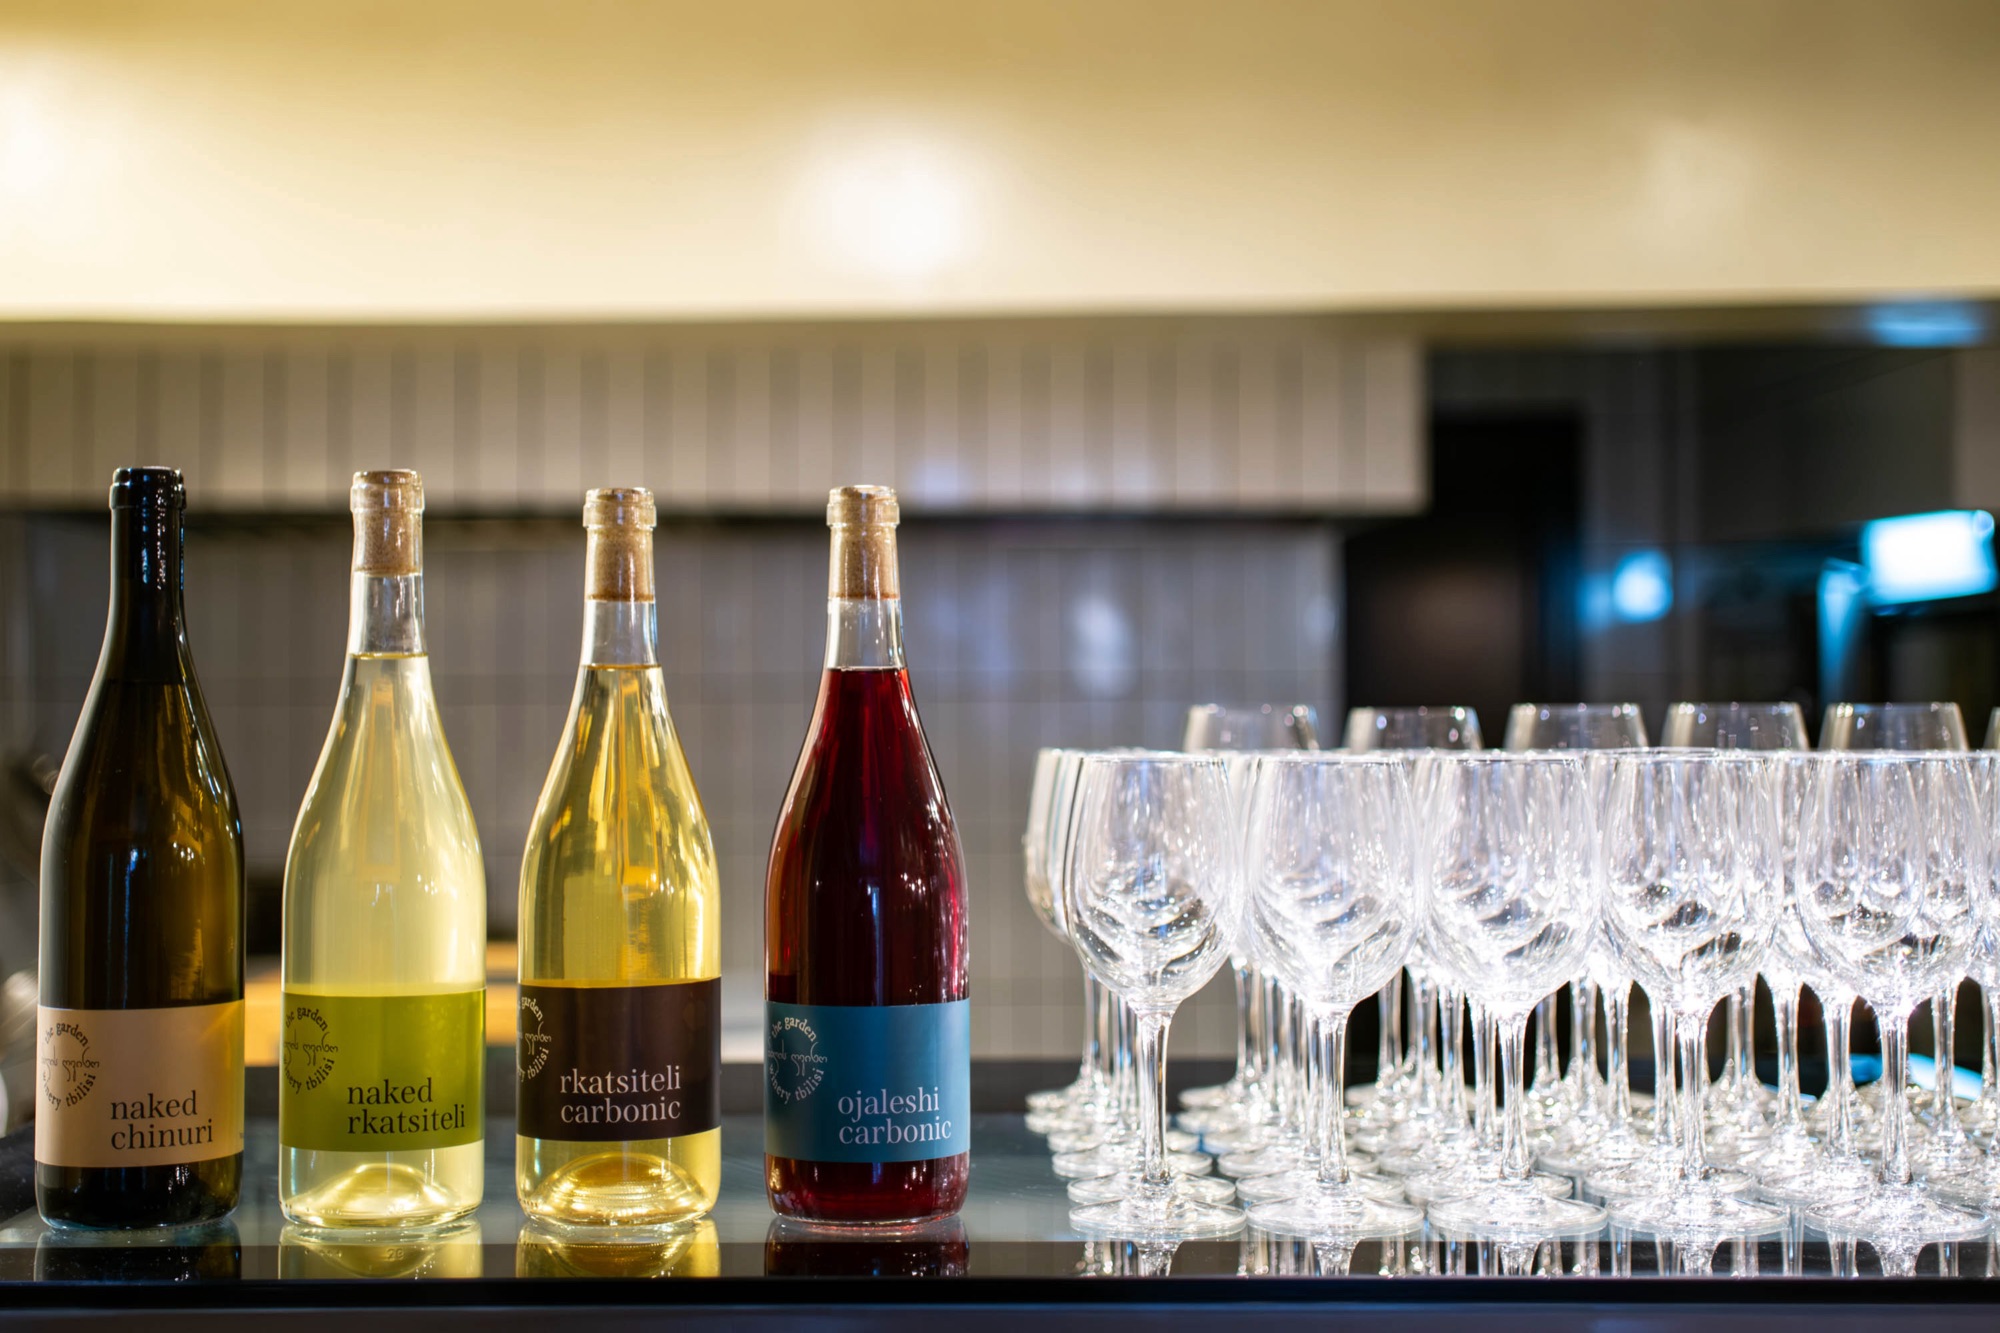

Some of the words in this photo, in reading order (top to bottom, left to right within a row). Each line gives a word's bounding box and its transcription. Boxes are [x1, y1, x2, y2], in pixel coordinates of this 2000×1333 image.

[56, 1022, 89, 1048] garden
[296, 1007, 328, 1032] garden
[771, 1020, 783, 1039] the
[784, 1017, 818, 1042] garden
[305, 1057, 335, 1091] tbilisi
[526, 1046, 550, 1080] tbilisi
[65, 1073, 97, 1107] tbilisi
[347, 1077, 434, 1106] naked
[560, 1065, 682, 1094] rkatsiteli
[795, 1067, 825, 1101] tbilisi
[110, 1090, 198, 1121] naked
[347, 1104, 466, 1135] rkatsiteli
[560, 1094, 682, 1124] carbonic
[838, 1086, 941, 1123] ojaleshi
[111, 1118, 214, 1151] chinuri
[838, 1115, 953, 1145] carbonic
